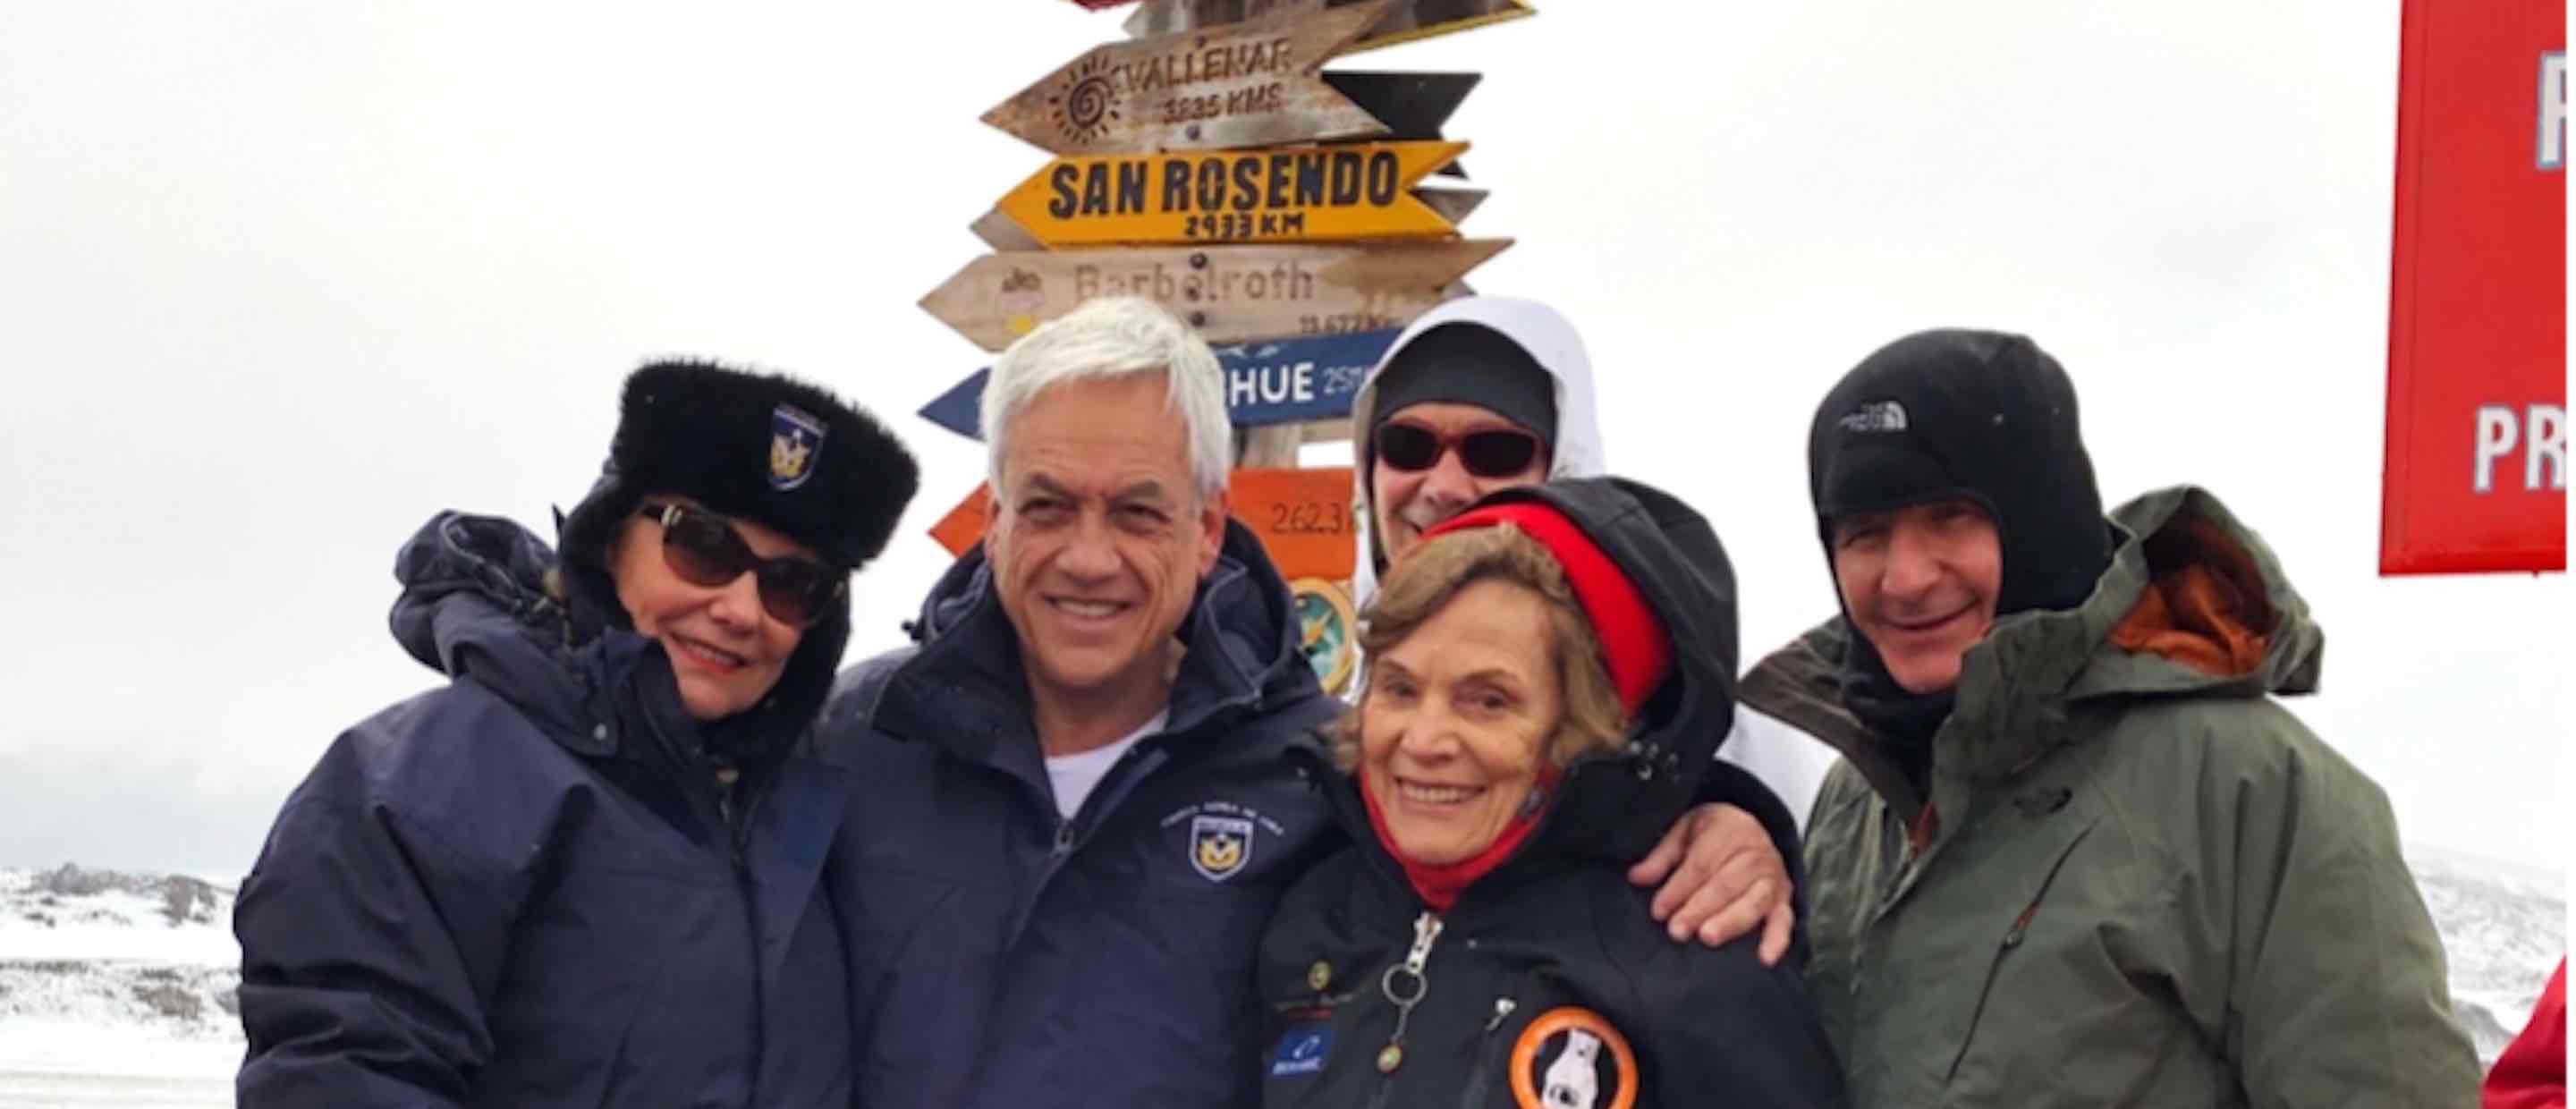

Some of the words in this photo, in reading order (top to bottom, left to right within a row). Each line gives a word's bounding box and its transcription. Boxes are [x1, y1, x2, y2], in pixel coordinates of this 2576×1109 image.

[1048, 161, 1148, 220] SAN
[1162, 150, 1399, 212] ROSENDO
[1184, 215, 1251, 238] 2933
[1260, 213, 1305, 234] KM
